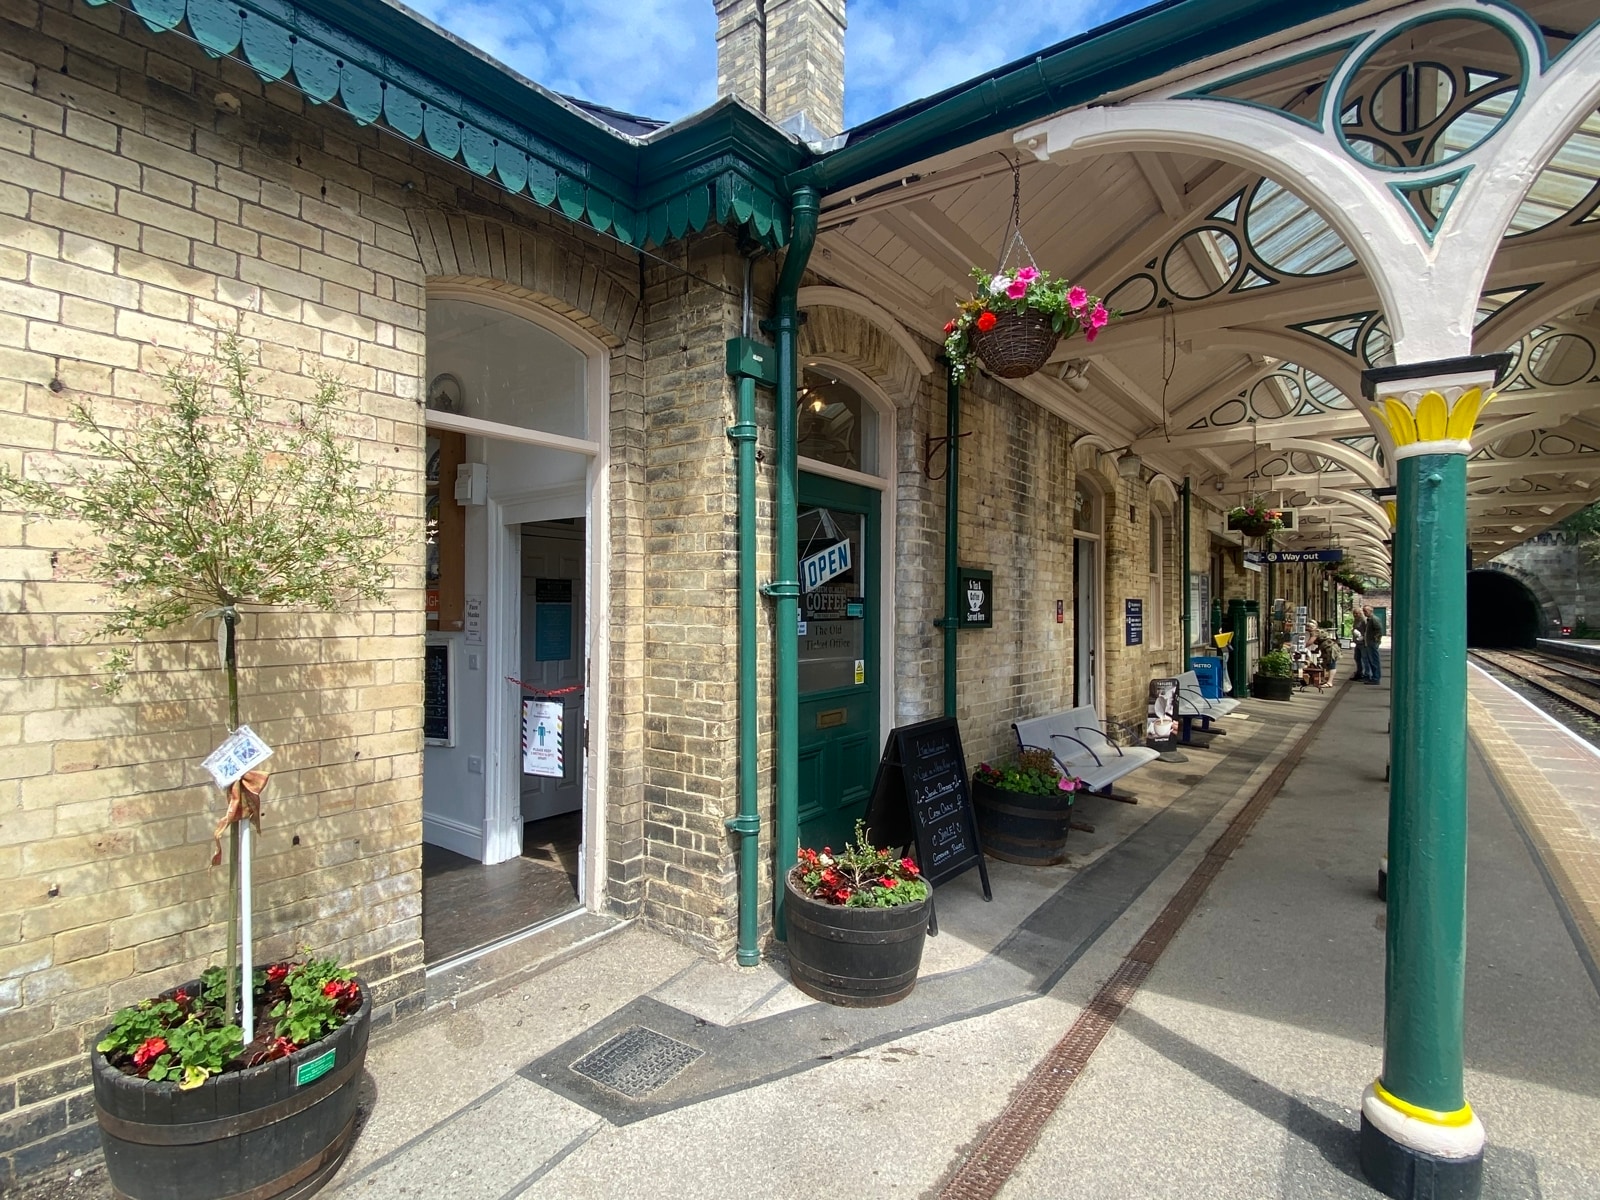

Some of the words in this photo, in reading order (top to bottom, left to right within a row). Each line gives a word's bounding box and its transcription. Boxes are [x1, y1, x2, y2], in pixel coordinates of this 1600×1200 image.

[1281, 553, 1300, 561] Way
[807, 543, 849, 587] OPEN
[806, 593, 847, 611] COFFEE
[815, 625, 827, 635] The
[829, 624, 842, 635] Old
[805, 639, 828, 651] Ticket
[829, 638, 851, 649] Office
